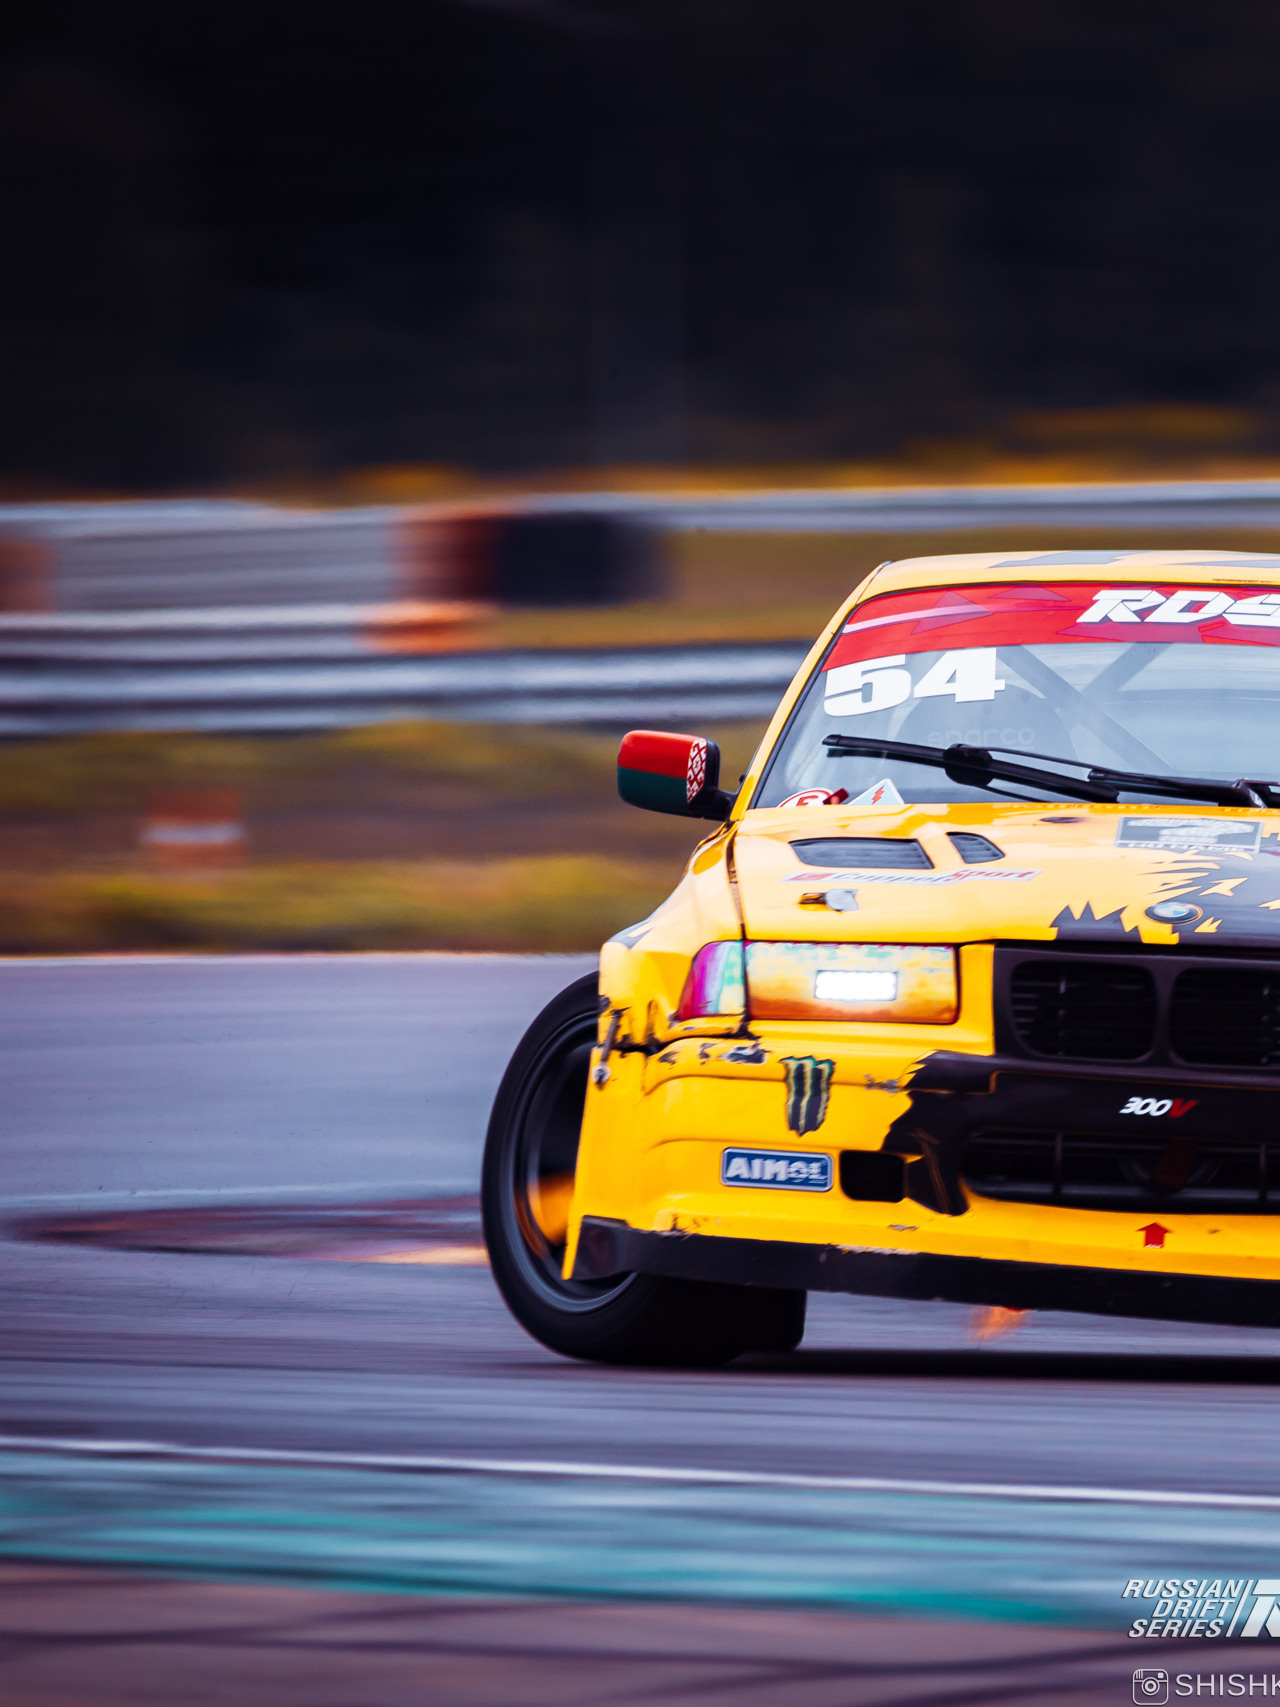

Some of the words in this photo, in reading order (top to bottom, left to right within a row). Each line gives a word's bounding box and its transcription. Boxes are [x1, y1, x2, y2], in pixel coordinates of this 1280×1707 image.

[823, 647, 1006, 717] 54
[1118, 1096, 1200, 1118] 300V
[725, 1157, 828, 1184] AIMOL
